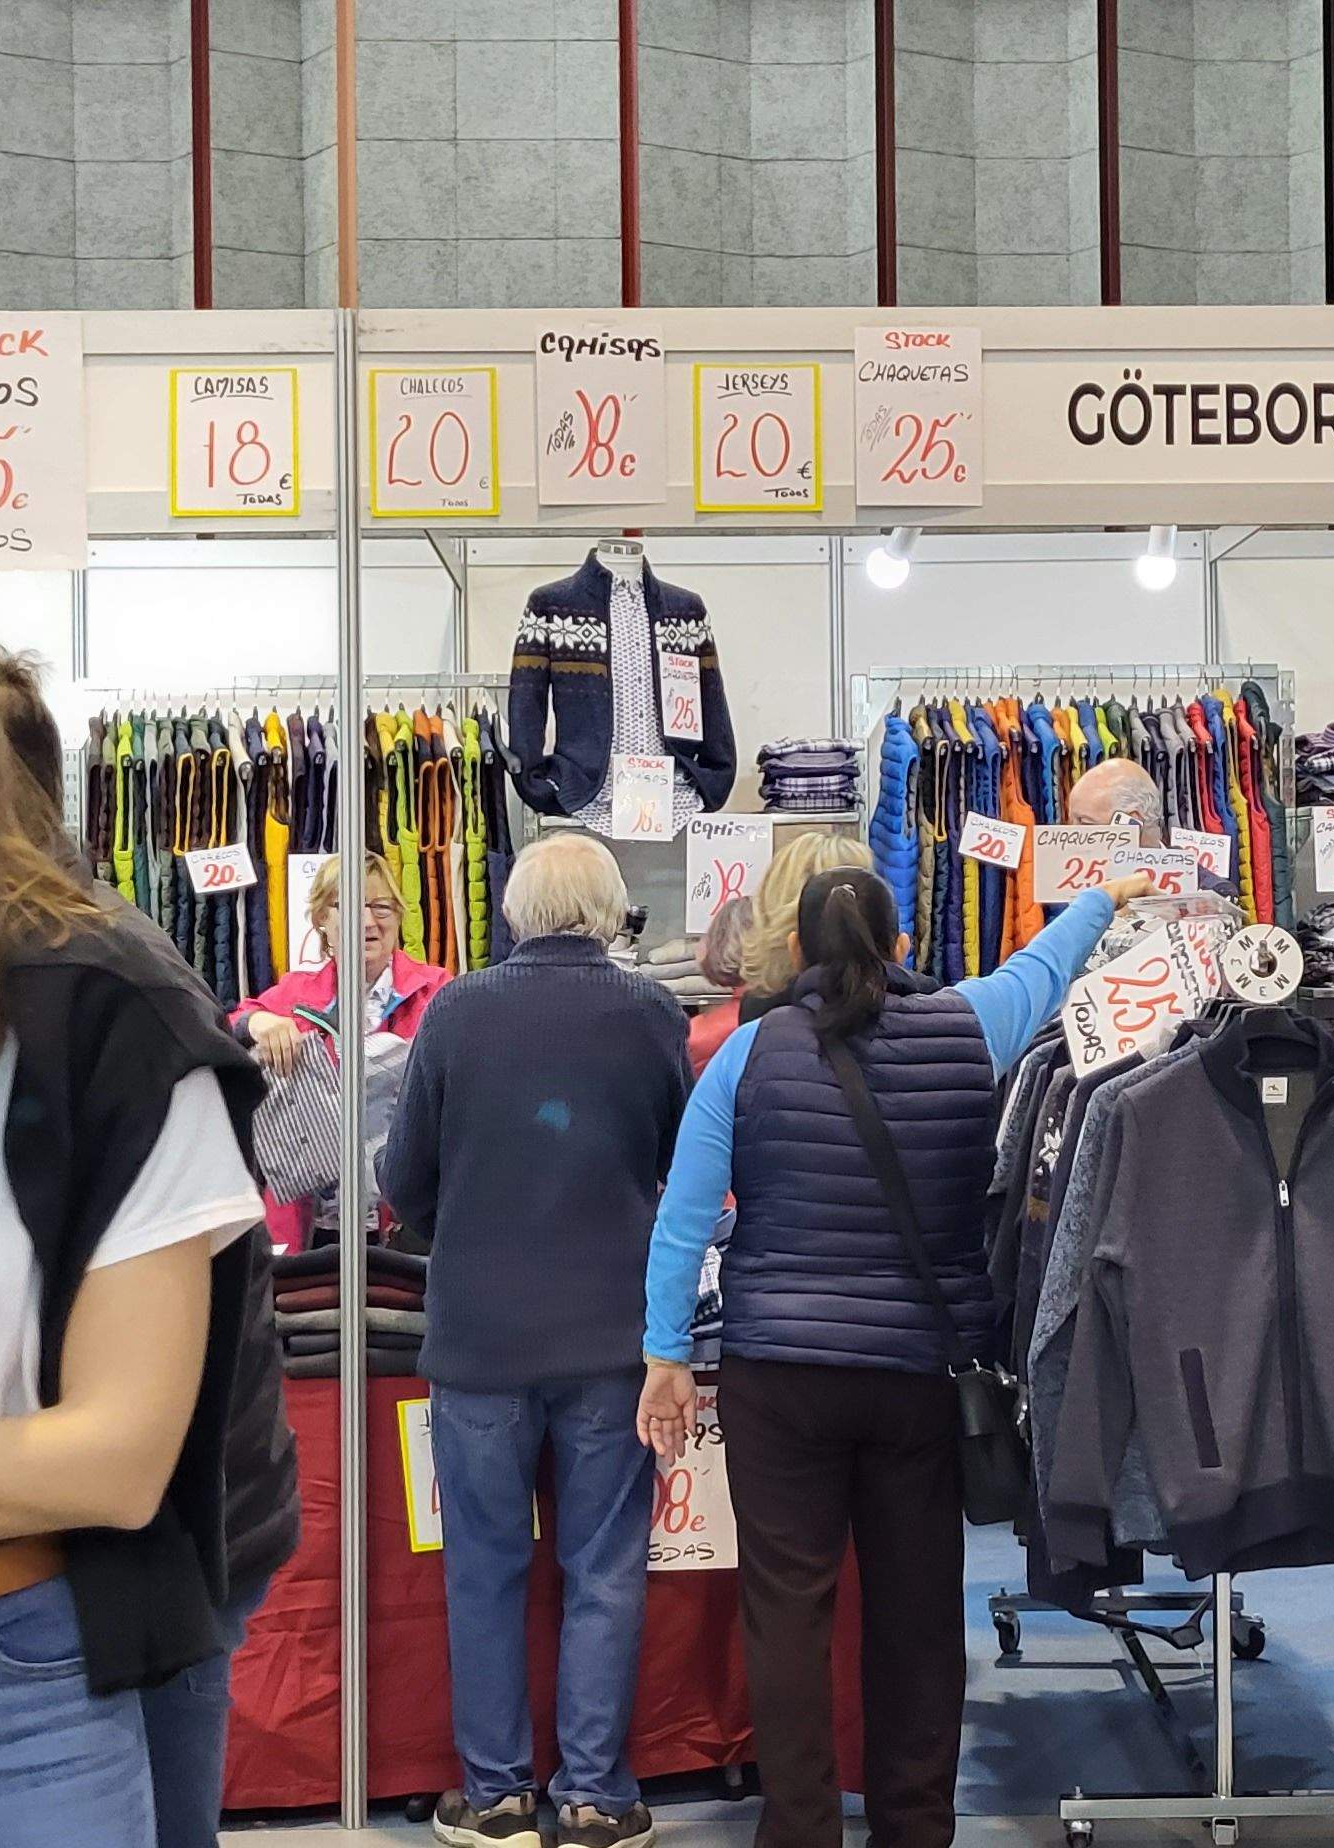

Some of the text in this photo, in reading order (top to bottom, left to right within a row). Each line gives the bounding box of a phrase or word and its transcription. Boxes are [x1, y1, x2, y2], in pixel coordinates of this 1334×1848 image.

[886, 331, 950, 350] STOCK
[858, 361, 969, 384] CHAQUETAS
[194, 376, 269, 397] CAMISAS
[400, 377, 464, 396] CHALECOS
[718, 372, 789, 396] JERSEYS
[236, 493, 282, 506] TODAS
[763, 488, 809, 498] TODOS
[669, 655, 694, 668] STOCK
[626, 757, 665, 769] STOCK
[1038, 831, 1131, 850] CHAQUETAS
[1114, 852, 1195, 866] CHAQUETAS
[1070, 986, 1106, 1065] TODAS
[648, 1542, 715, 1563] ODAS
